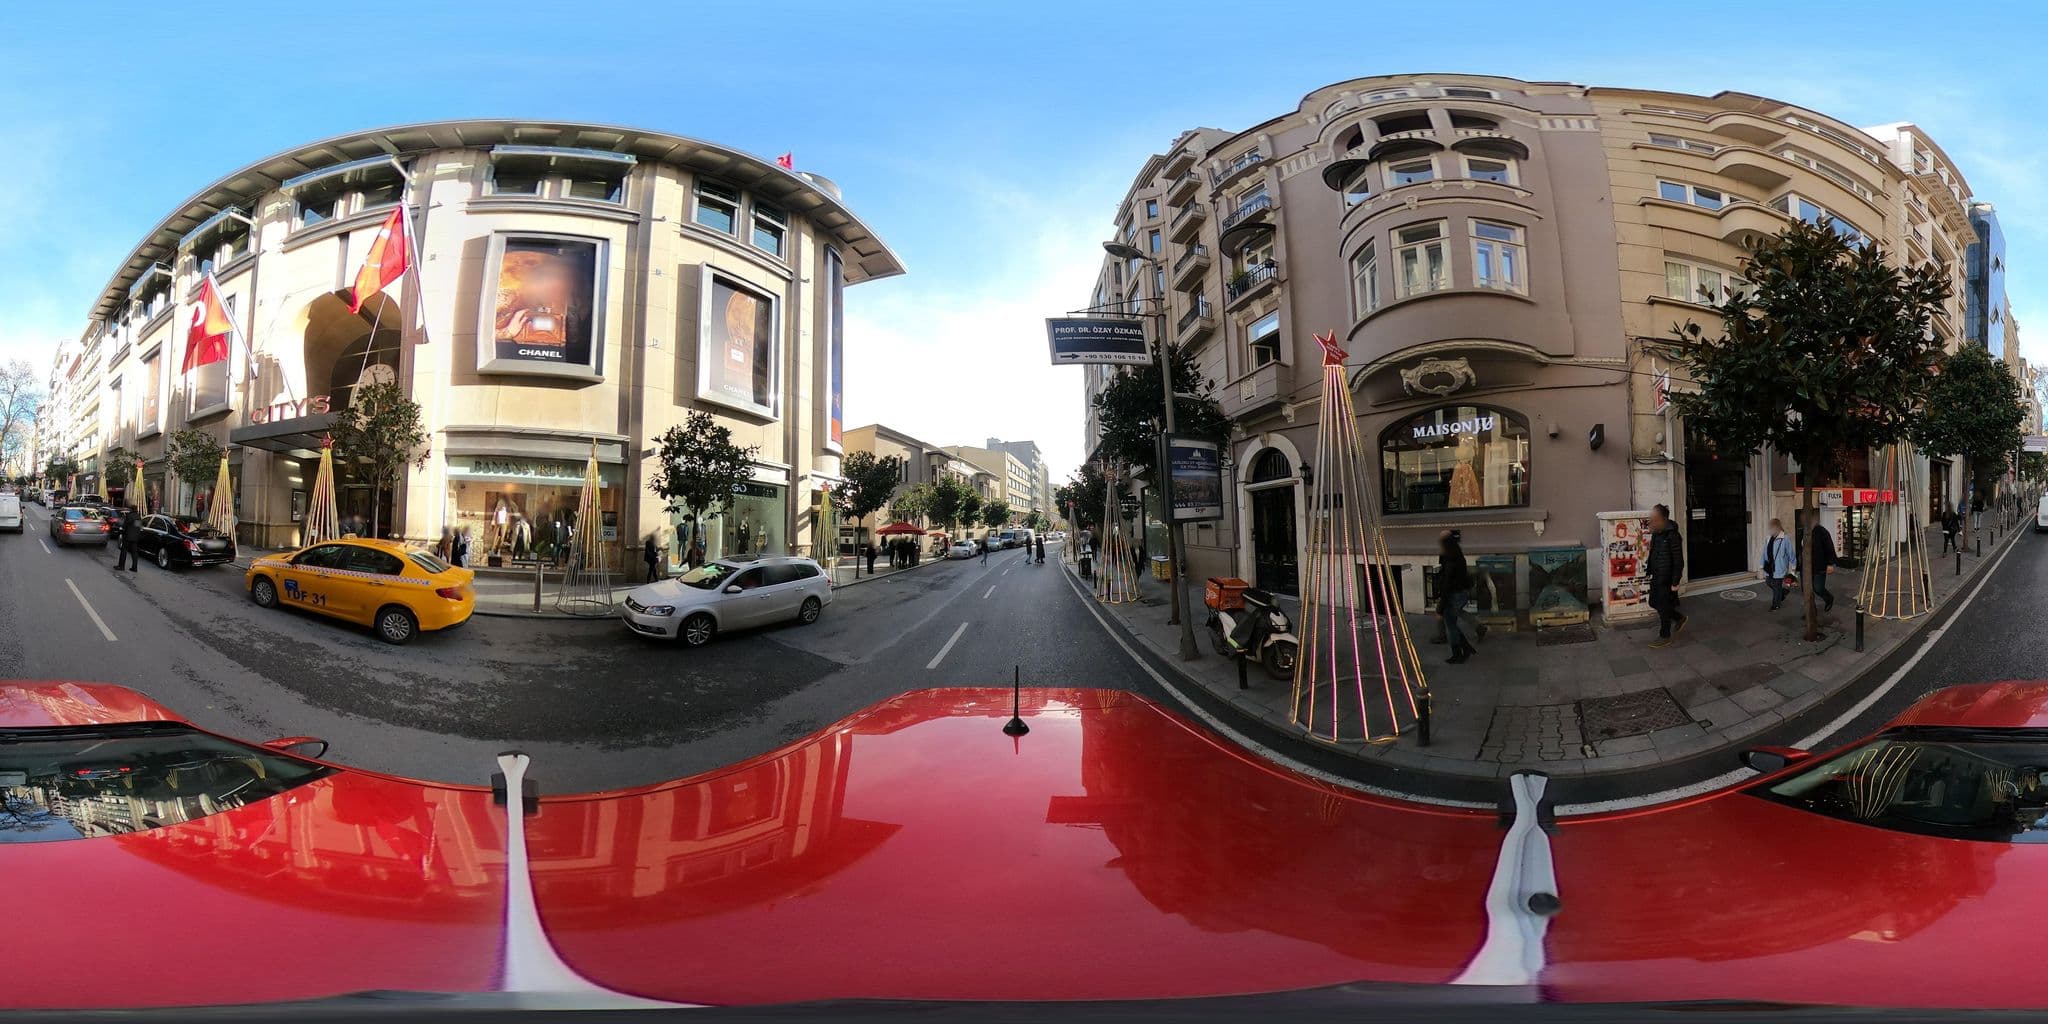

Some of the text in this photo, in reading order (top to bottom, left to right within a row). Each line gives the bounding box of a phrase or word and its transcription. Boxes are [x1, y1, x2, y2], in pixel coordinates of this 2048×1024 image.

[1055, 326, 1076, 334] PROF.
[1092, 325, 1112, 334] ÖZAY
[1114, 326, 1143, 335] ÖZKAYA
[518, 348, 563, 358] CHANEL
[1413, 421, 1472, 438] MAISON
[312, 592, 326, 607] 31
